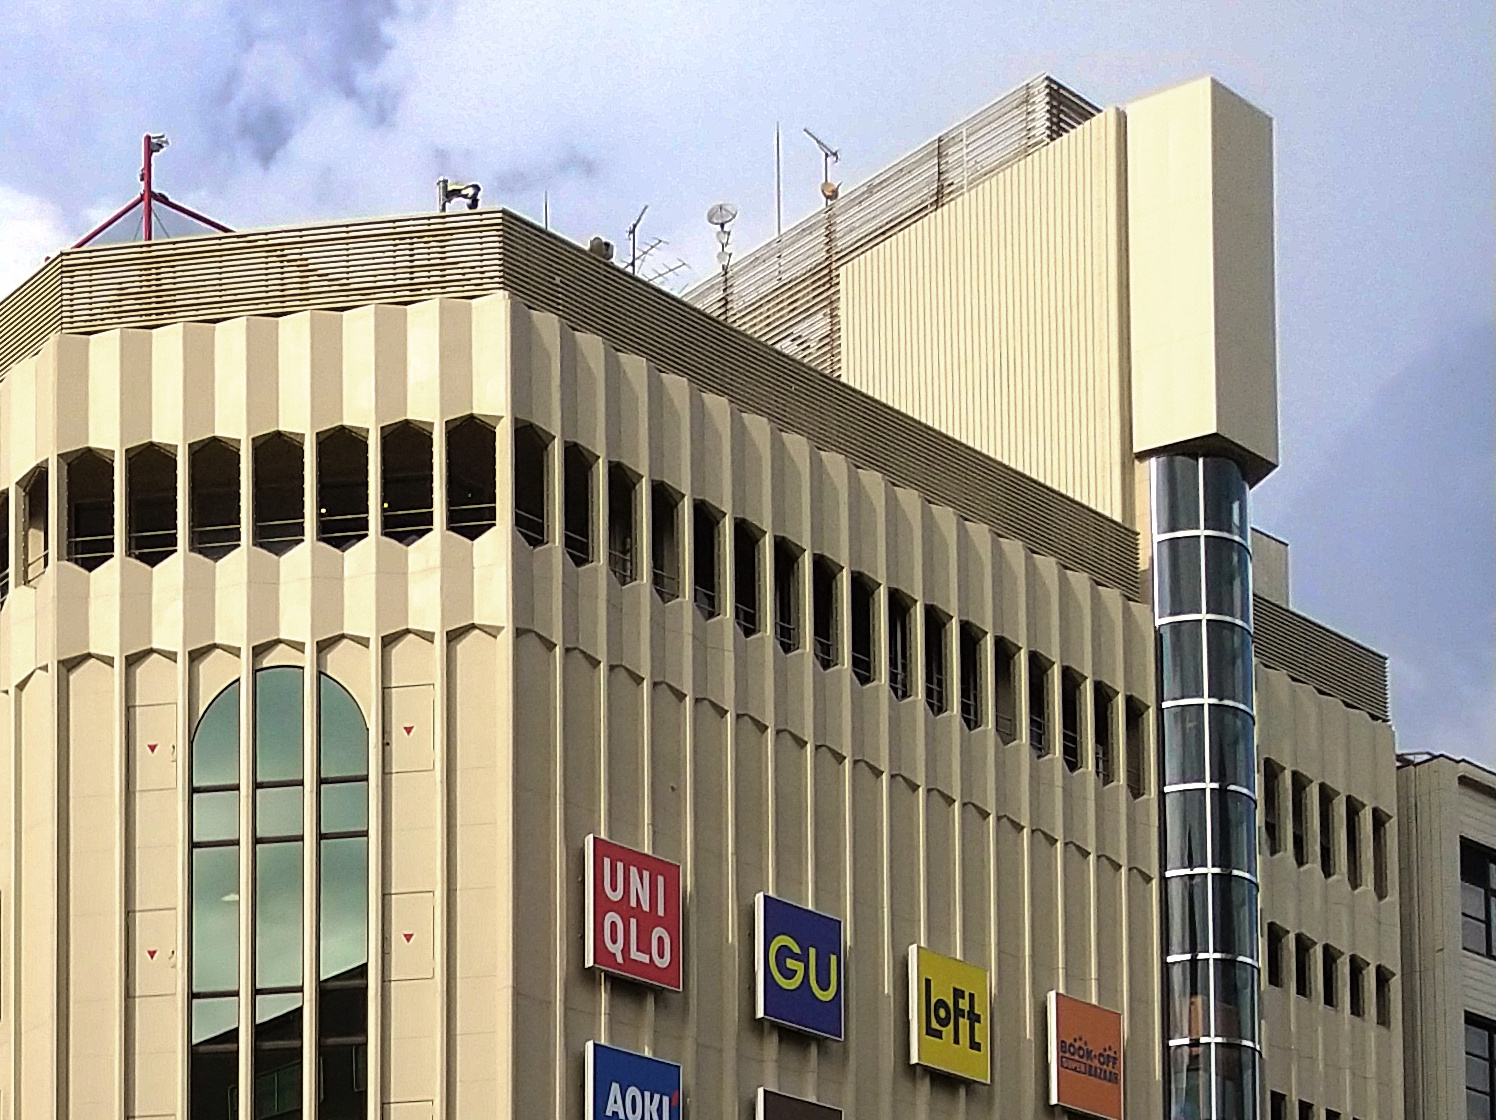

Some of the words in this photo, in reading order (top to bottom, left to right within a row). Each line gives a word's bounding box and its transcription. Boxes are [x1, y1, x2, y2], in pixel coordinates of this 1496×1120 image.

[604, 857, 665, 917] UNI
[604, 912, 671, 968] QLO
[768, 935, 838, 1002] GU
